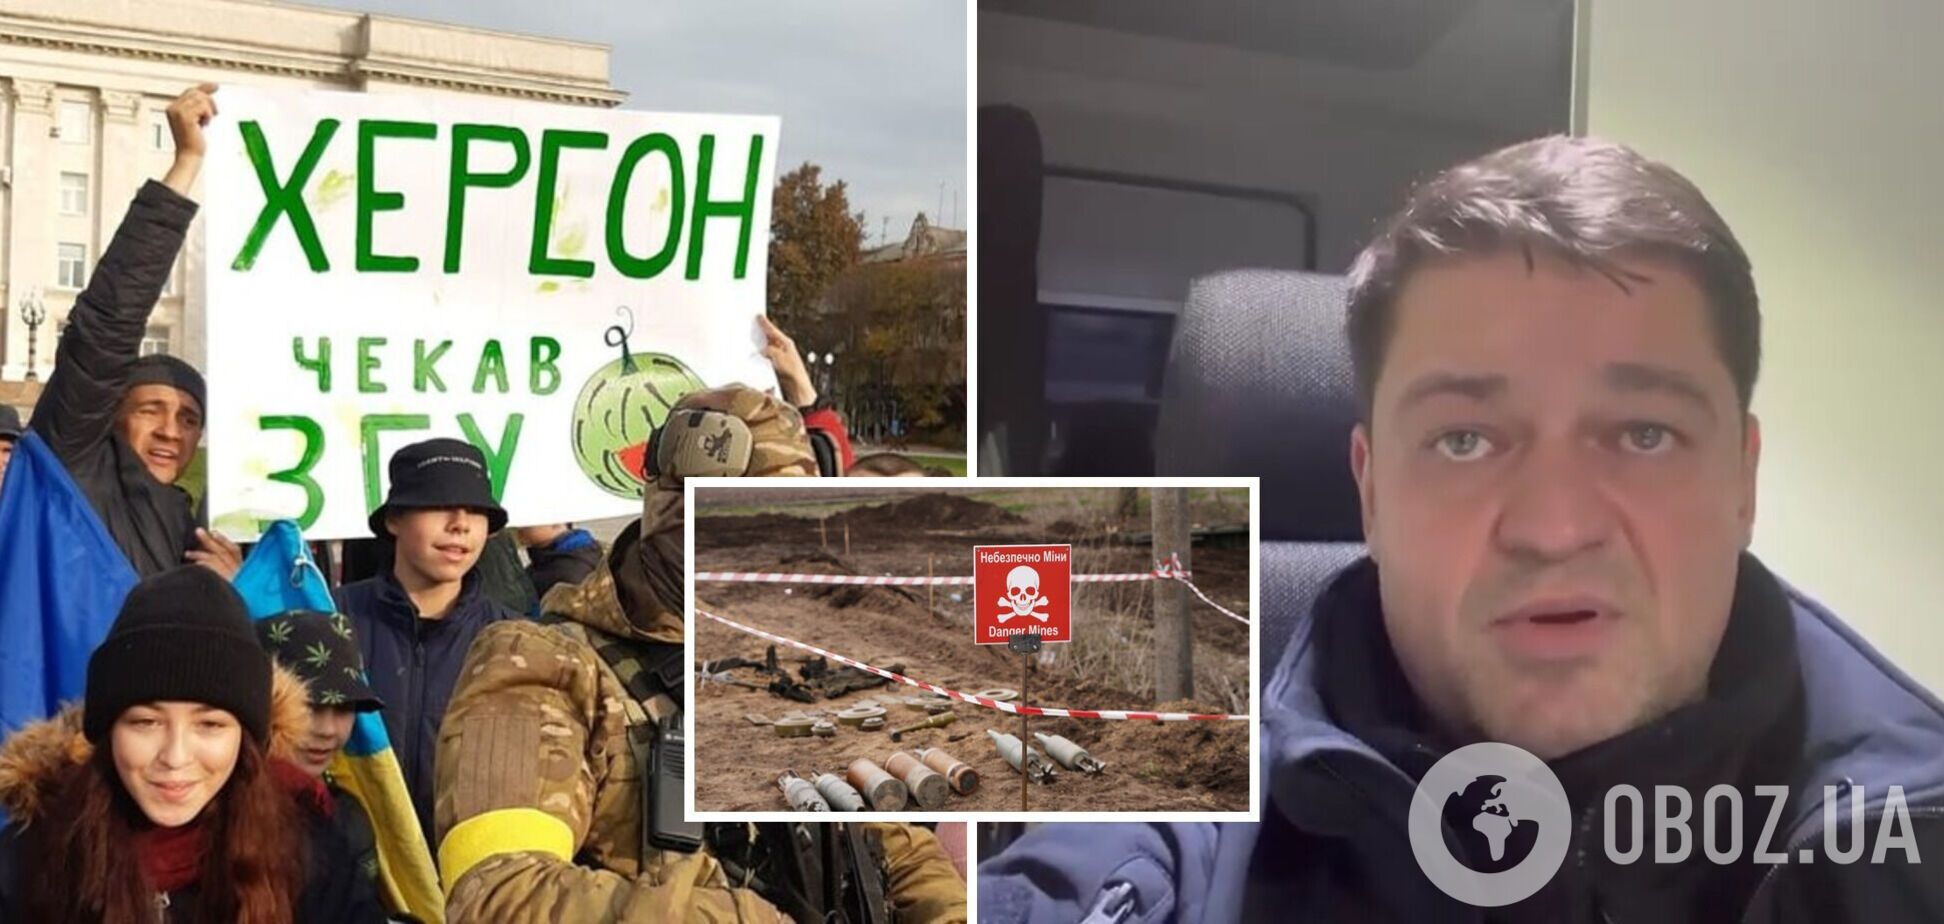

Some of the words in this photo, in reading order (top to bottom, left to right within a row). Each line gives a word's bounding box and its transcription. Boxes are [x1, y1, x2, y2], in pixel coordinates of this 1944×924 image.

[231, 118, 764, 281] ХЕРСОН
[292, 335, 562, 394] ЧЕКАВ
[980, 551, 1040, 564] Небезпечно
[1043, 550, 1067, 562] Міни
[1028, 625, 1058, 637] Mines
